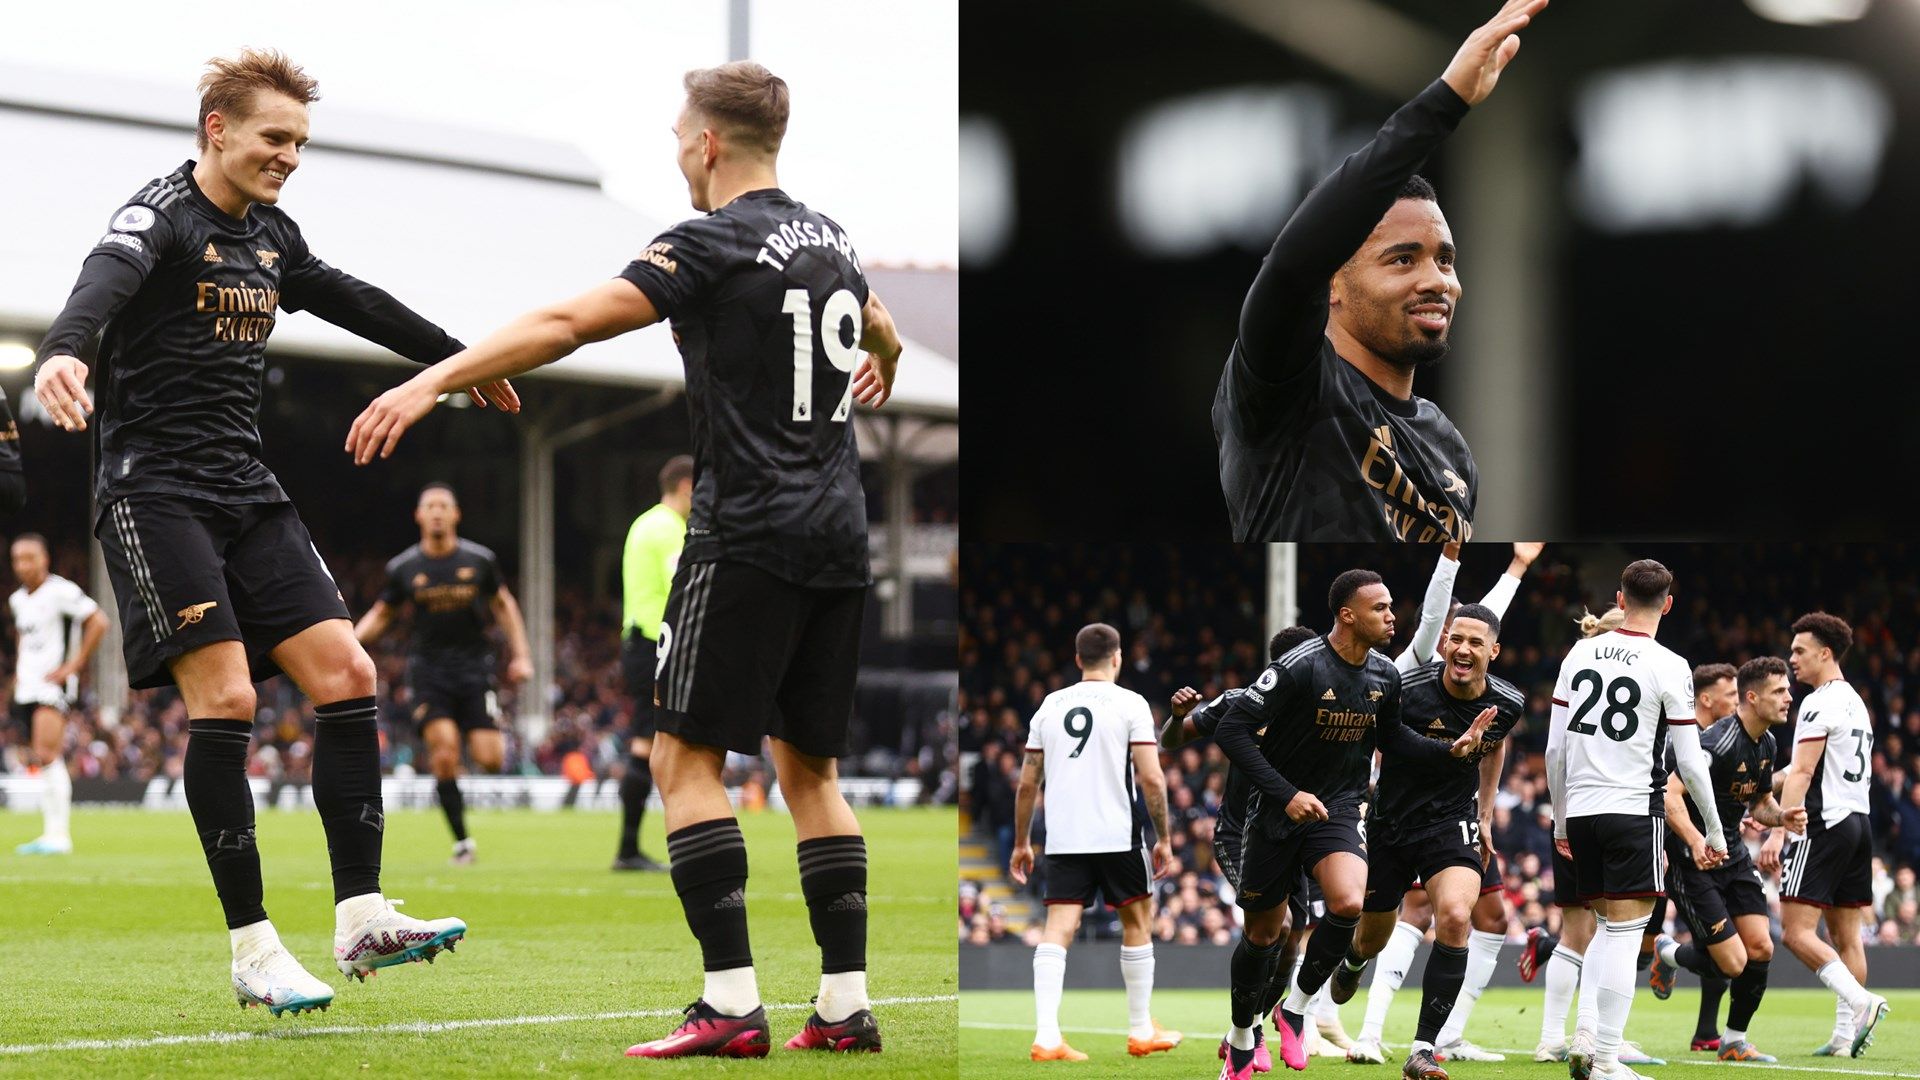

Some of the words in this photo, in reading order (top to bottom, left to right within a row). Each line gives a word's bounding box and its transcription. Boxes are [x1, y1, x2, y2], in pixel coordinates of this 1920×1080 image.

[638, 249, 677, 275] ANDA
[196, 281, 280, 313] Emirate
[214, 317, 239, 342] FLY
[239, 317, 275, 342] BETT
[781, 289, 863, 422] 19
[1595, 646, 1640, 666] LUKIĆ
[1567, 669, 1642, 742] 28
[1063, 706, 1094, 758] 9
[1458, 820, 1480, 845] 12
